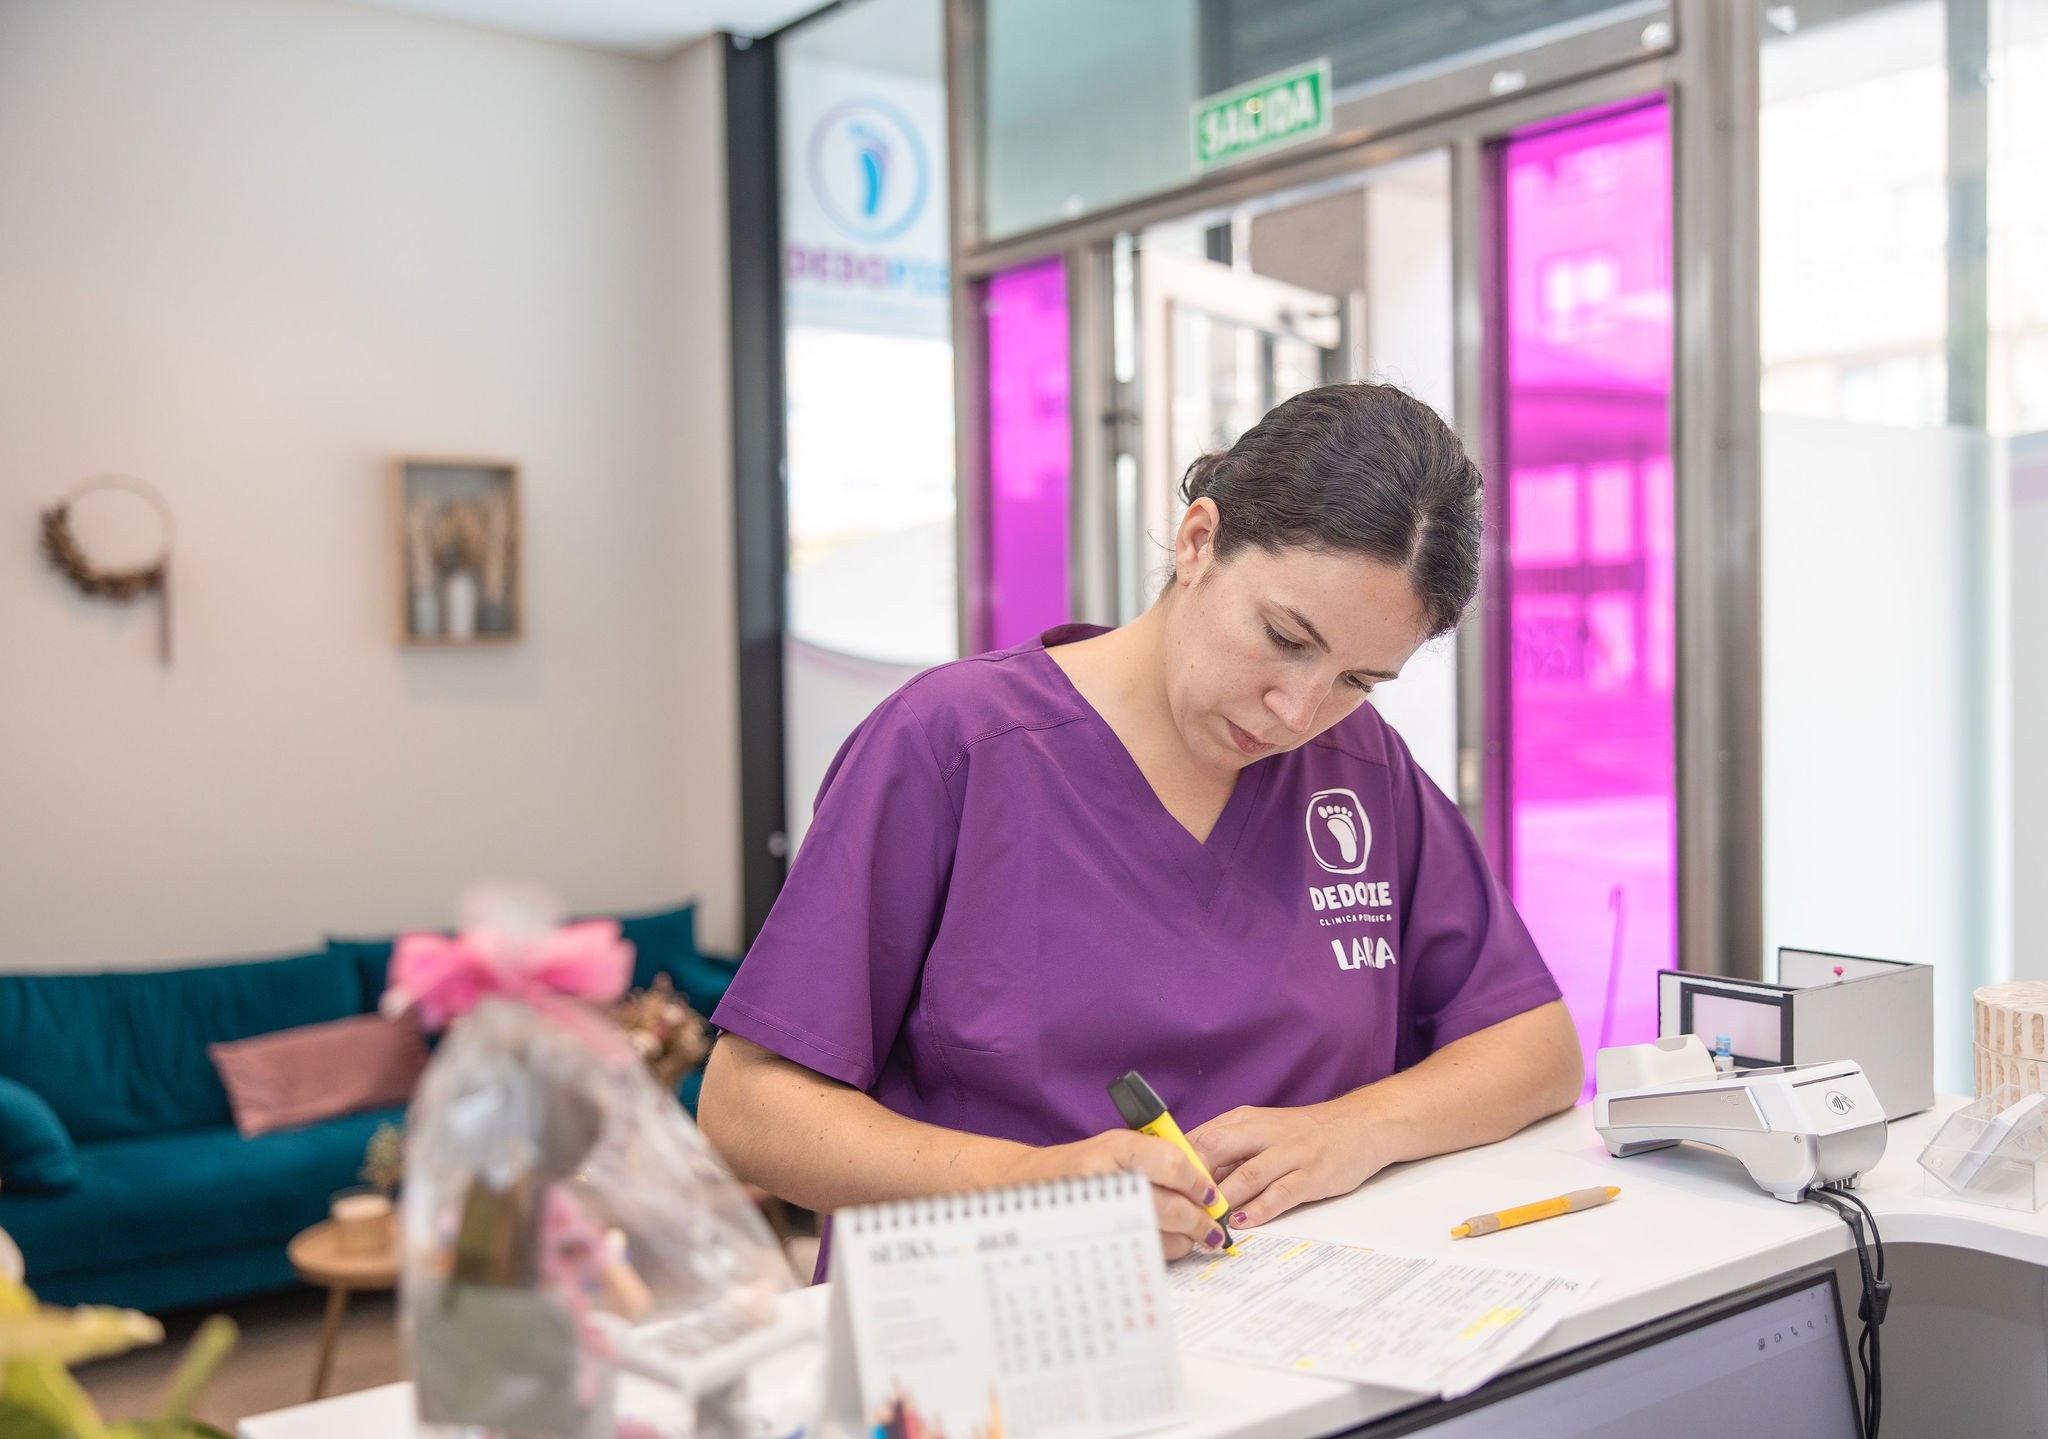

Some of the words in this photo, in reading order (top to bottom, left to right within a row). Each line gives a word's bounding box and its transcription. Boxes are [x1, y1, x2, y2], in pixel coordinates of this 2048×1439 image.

[1203, 80, 1317, 155] SALIDA
[1309, 881, 1392, 911] DEDOIE
[1319, 914, 1357, 927] CLINICA
[1331, 936, 1396, 970] LARA
